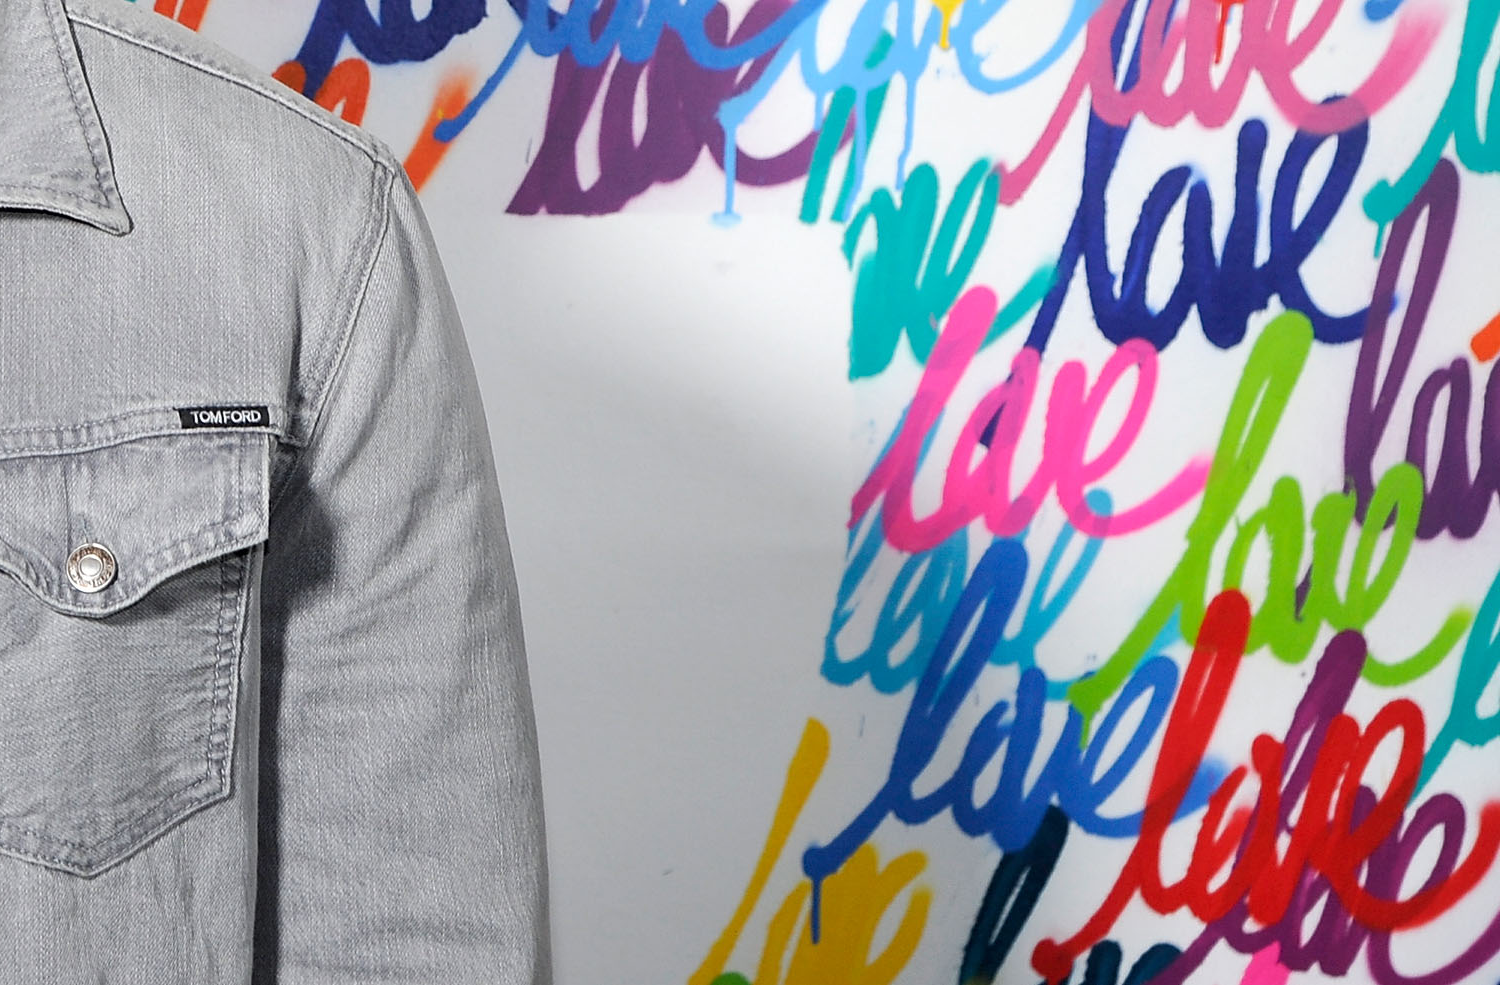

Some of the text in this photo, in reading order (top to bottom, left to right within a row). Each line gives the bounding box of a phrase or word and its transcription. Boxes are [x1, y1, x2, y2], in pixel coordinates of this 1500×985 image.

[847, 284, 1218, 554] love
[1066, 309, 1473, 716] love
[802, 538, 1232, 886] love
[1032, 588, 1500, 978] love
